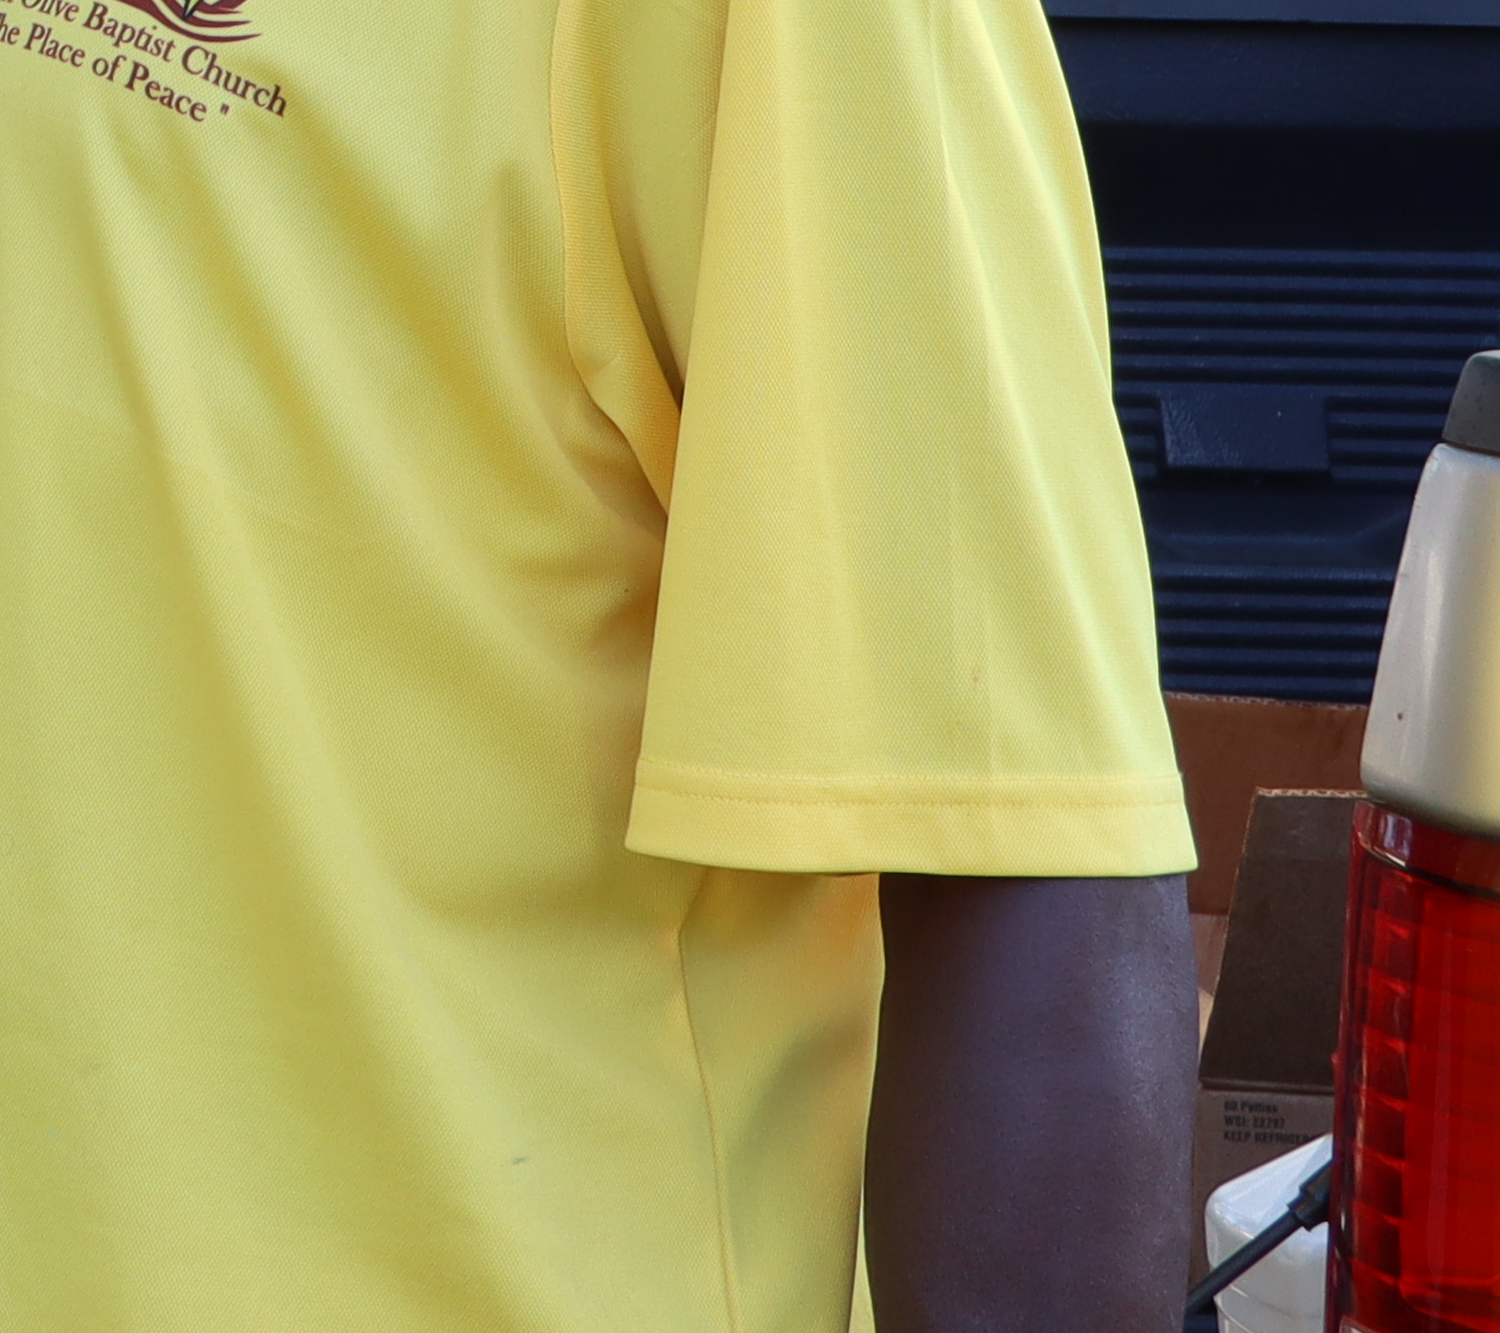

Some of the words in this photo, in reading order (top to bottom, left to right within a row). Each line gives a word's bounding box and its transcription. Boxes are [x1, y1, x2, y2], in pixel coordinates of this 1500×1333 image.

[23, 21, 86, 69] Place
[92, 54, 128, 82] of
[83, 0, 177, 63] Baptist
[181, 44, 288, 118] Church
[1223, 1130, 1251, 1143] KEEP
